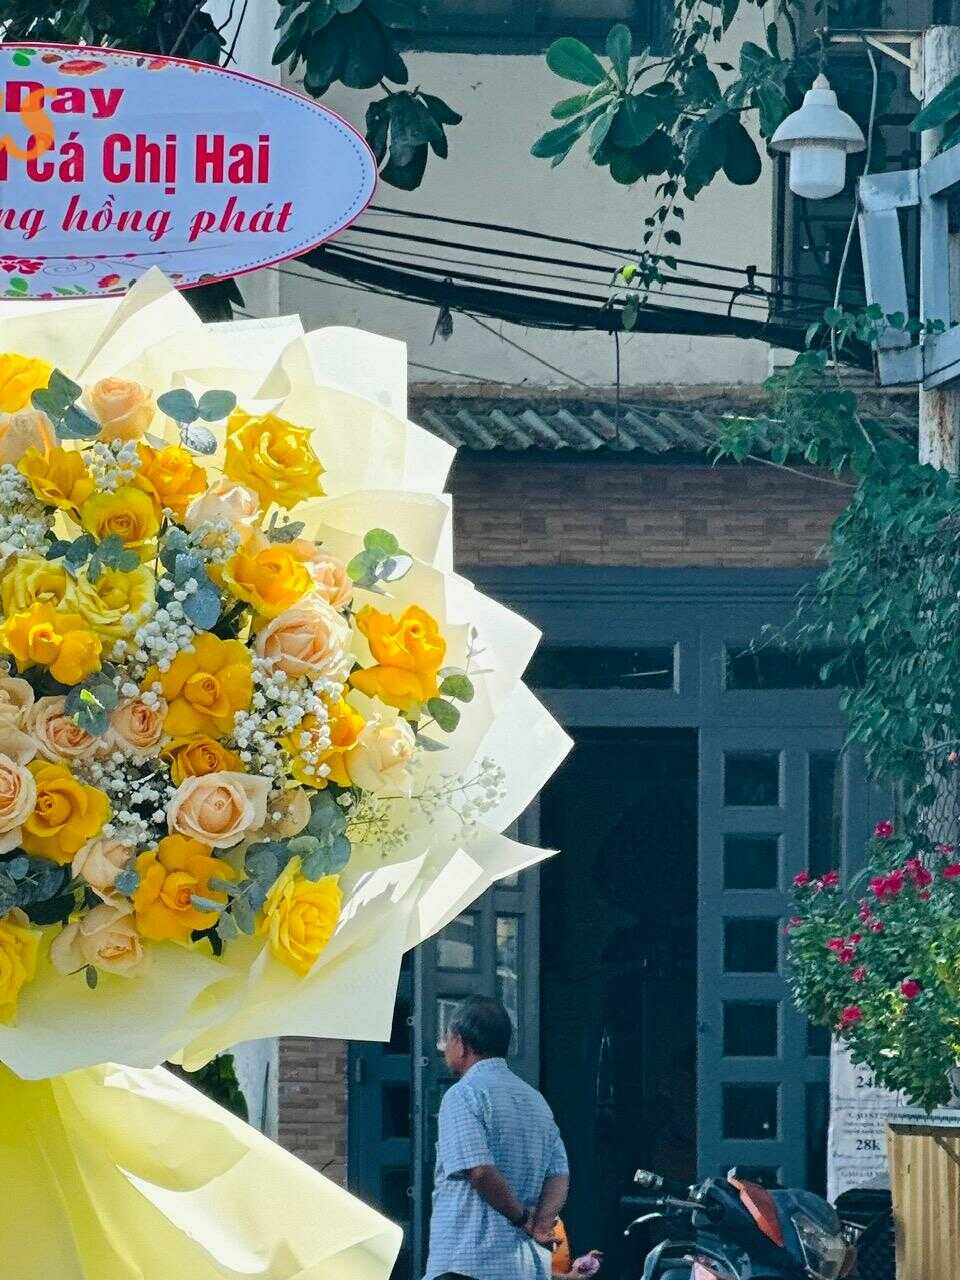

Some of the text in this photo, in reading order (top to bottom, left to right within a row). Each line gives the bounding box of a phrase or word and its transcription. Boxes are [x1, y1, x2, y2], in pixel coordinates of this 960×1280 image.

[5, 81, 125, 119] Day
[26, 131, 84, 184] Cá
[102, 132, 177, 196] Chị
[194, 134, 271, 185] Hai
[60, 194, 173, 243] hồng
[188, 195, 294, 243] phát
[856, 1138, 881, 1151] 28k
